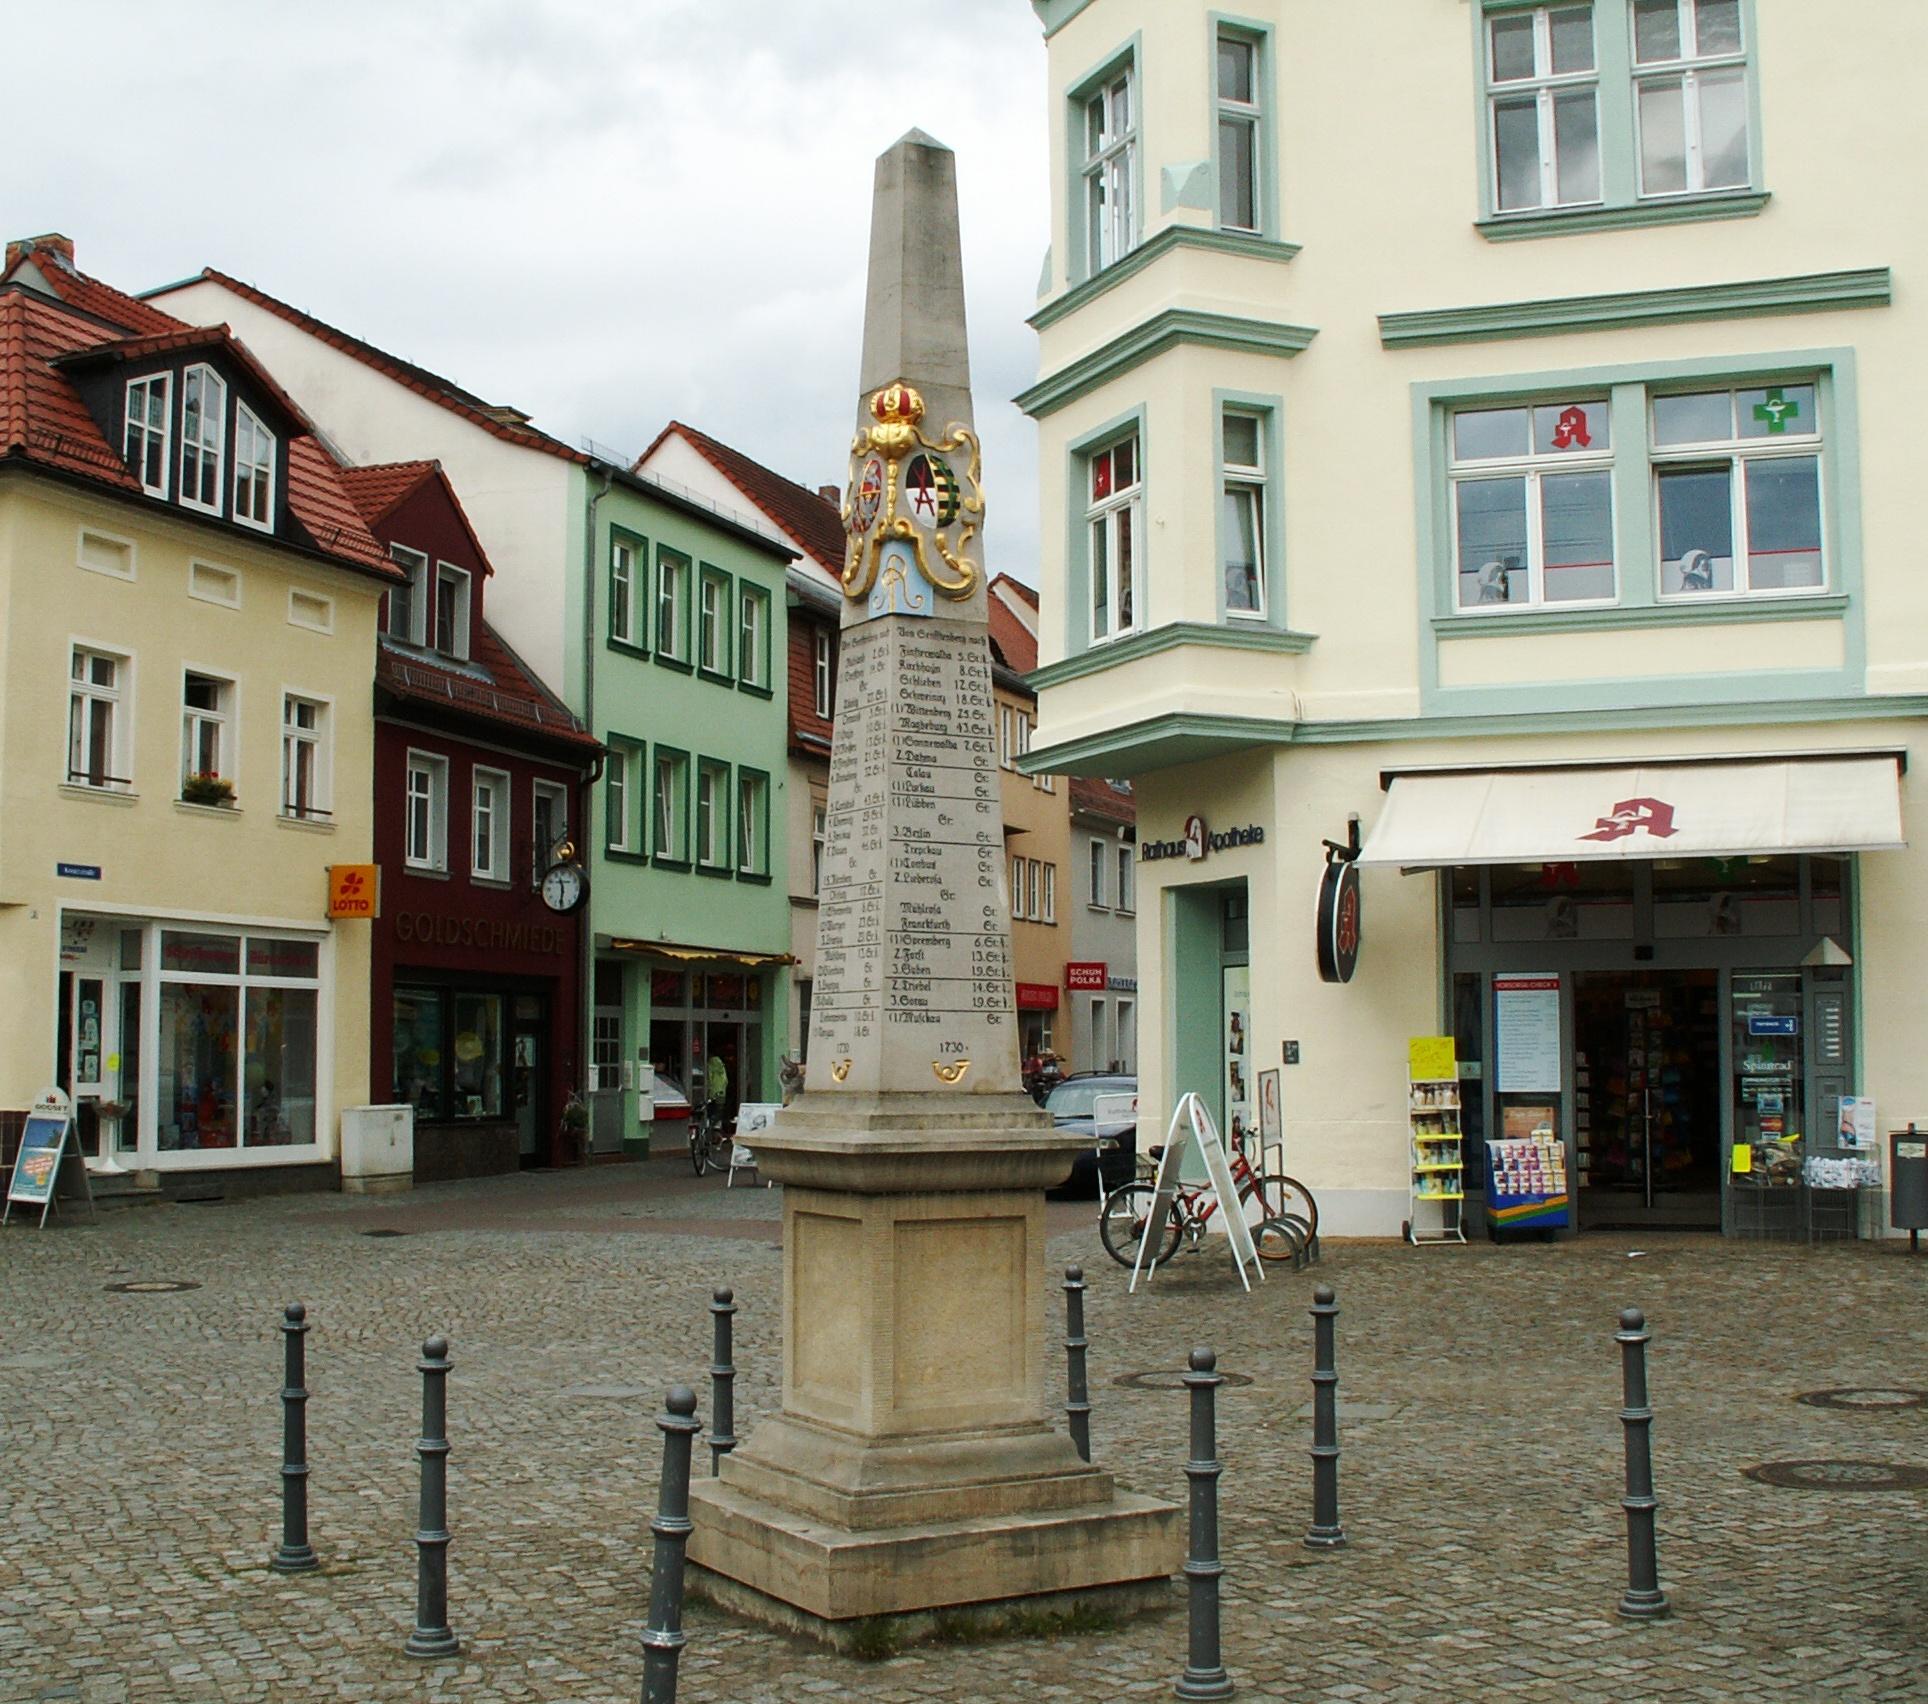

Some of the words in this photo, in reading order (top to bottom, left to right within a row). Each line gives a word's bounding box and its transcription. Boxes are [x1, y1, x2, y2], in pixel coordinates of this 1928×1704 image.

[1141, 840, 1187, 861] Rathaus
[1207, 823, 1265, 853] Apotheke
[333, 899, 369, 911] LOTTO
[396, 911, 566, 954] GOLDSCHMIEDE
